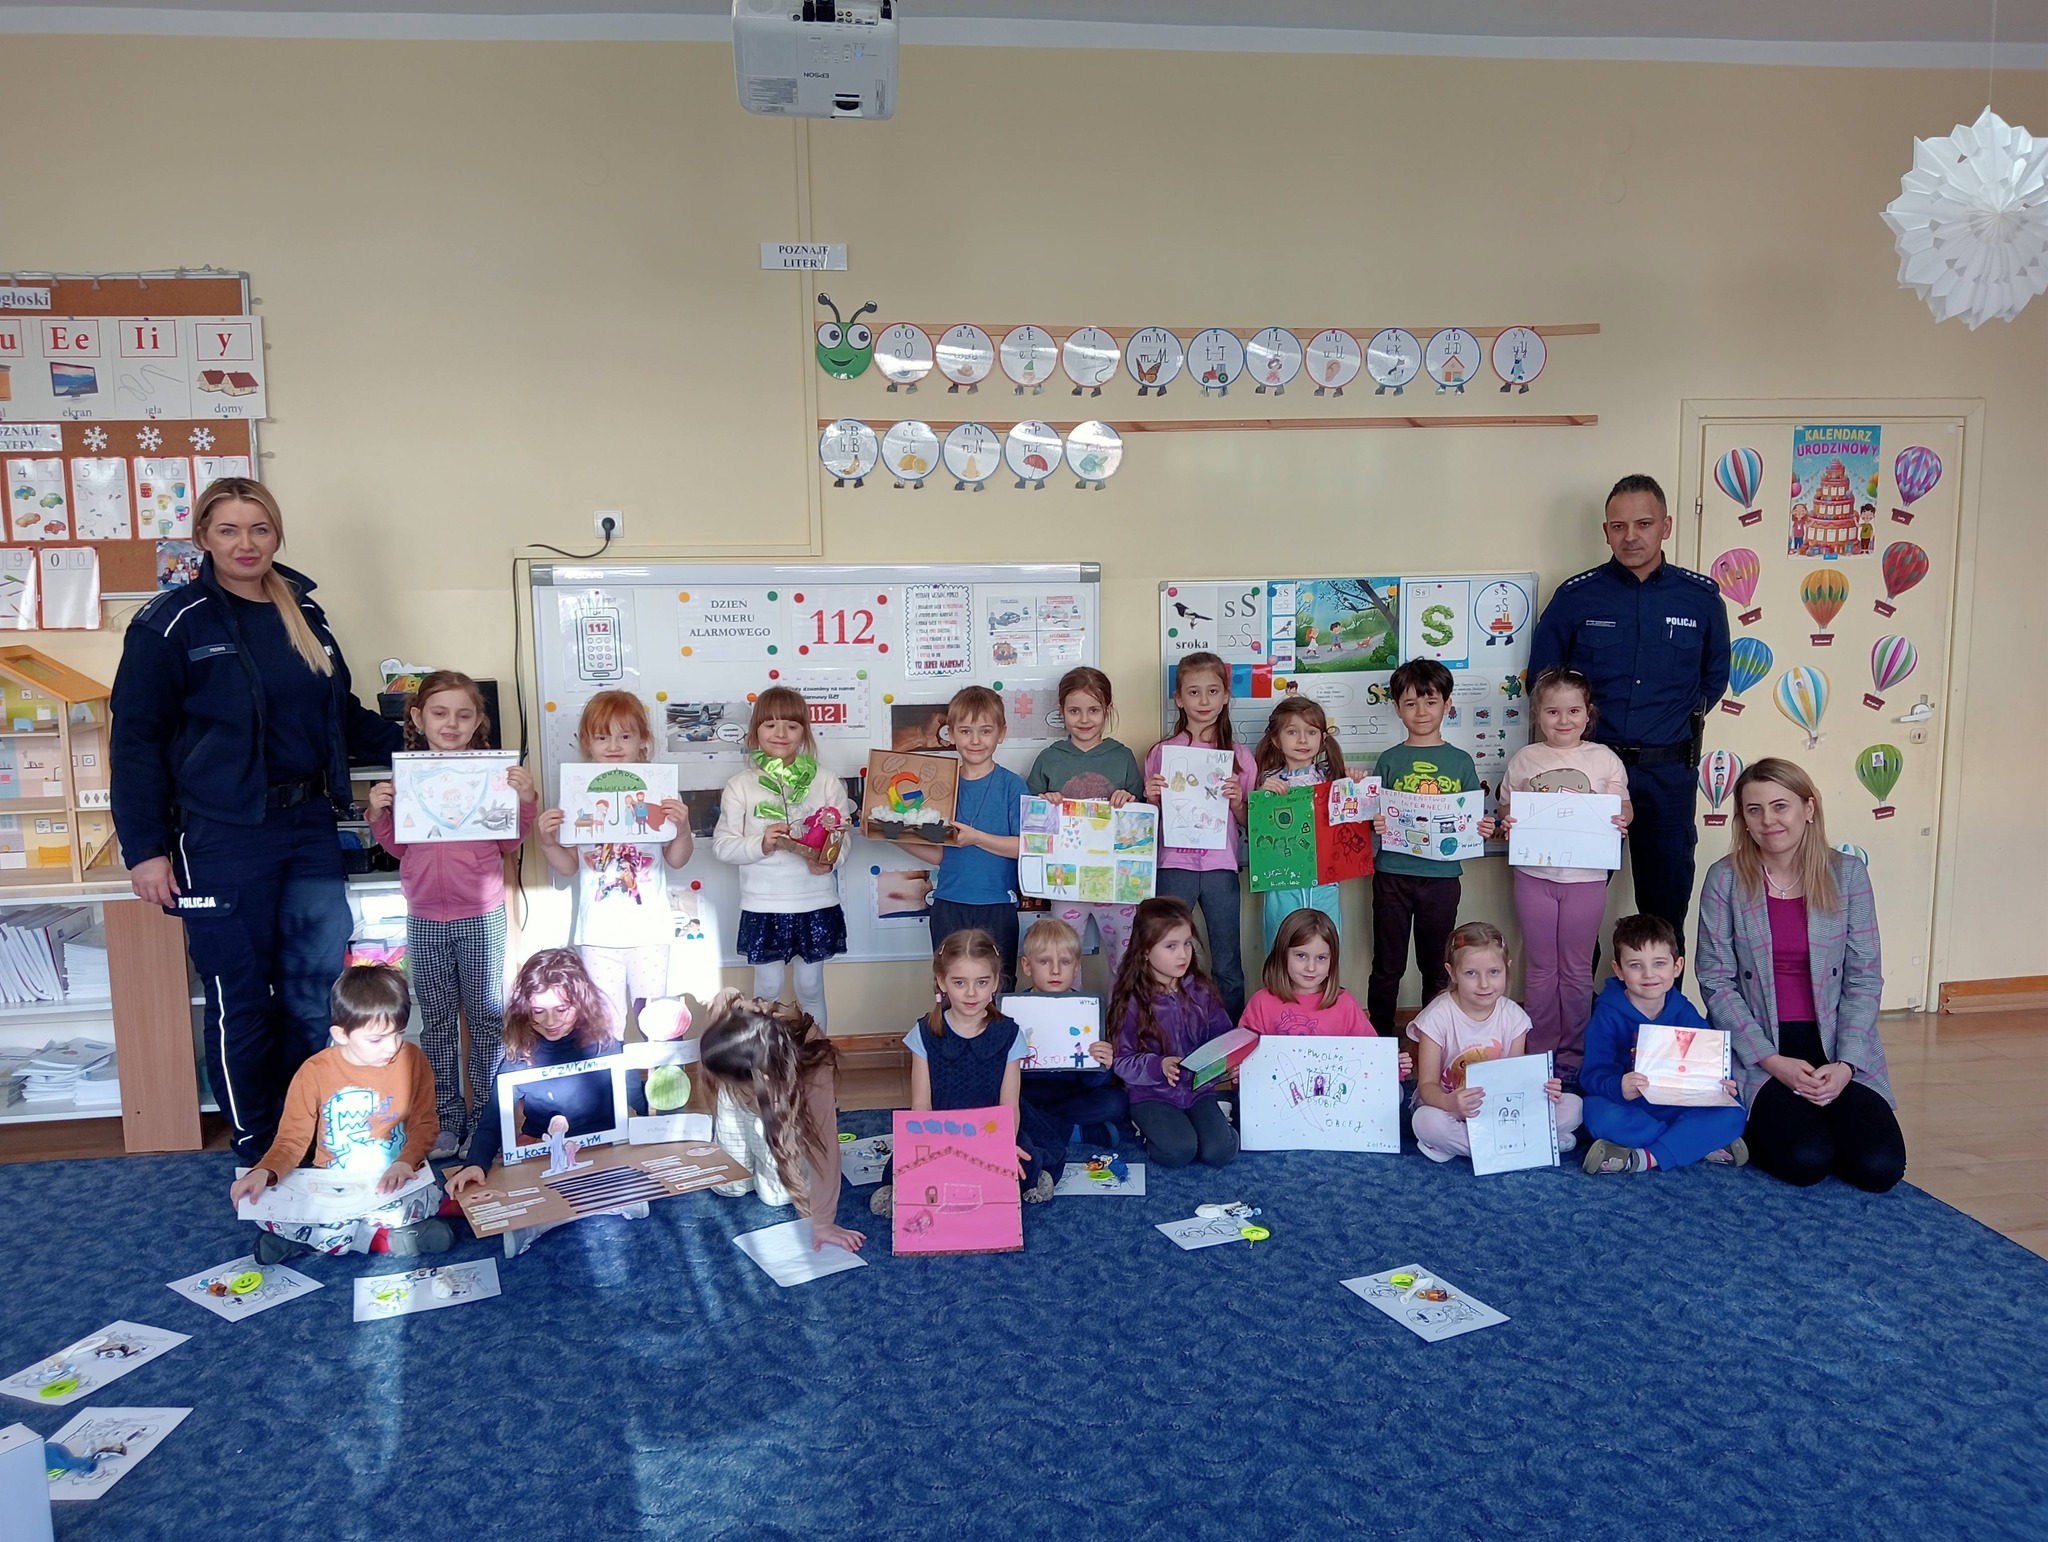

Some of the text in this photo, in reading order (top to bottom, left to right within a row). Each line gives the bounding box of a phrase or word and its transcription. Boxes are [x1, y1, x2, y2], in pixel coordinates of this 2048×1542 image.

[0, 291, 49, 308] głoski
[62, 407, 92, 418] ekran
[214, 402, 243, 416] domy
[1804, 428, 1873, 442] KALENDARZ
[1796, 442, 1878, 457] URODZINOWY
[17, 465, 27, 478] 4
[82, 463, 91, 478] 5
[144, 461, 154, 476] 6
[204, 461, 213, 475] 7
[711, 598, 748, 609] DZIEŃ
[704, 614, 755, 623] NUMERU
[1666, 617, 1697, 628] POLICJA
[588, 623, 609, 632] 112
[689, 628, 771, 637] ALARMOWEGO
[810, 609, 875, 645] 112
[1175, 638, 1209, 650] sroka
[810, 706, 835, 721] 112
[178, 896, 216, 909] POLICJA
[1043, 1055, 1068, 1065] STOP
